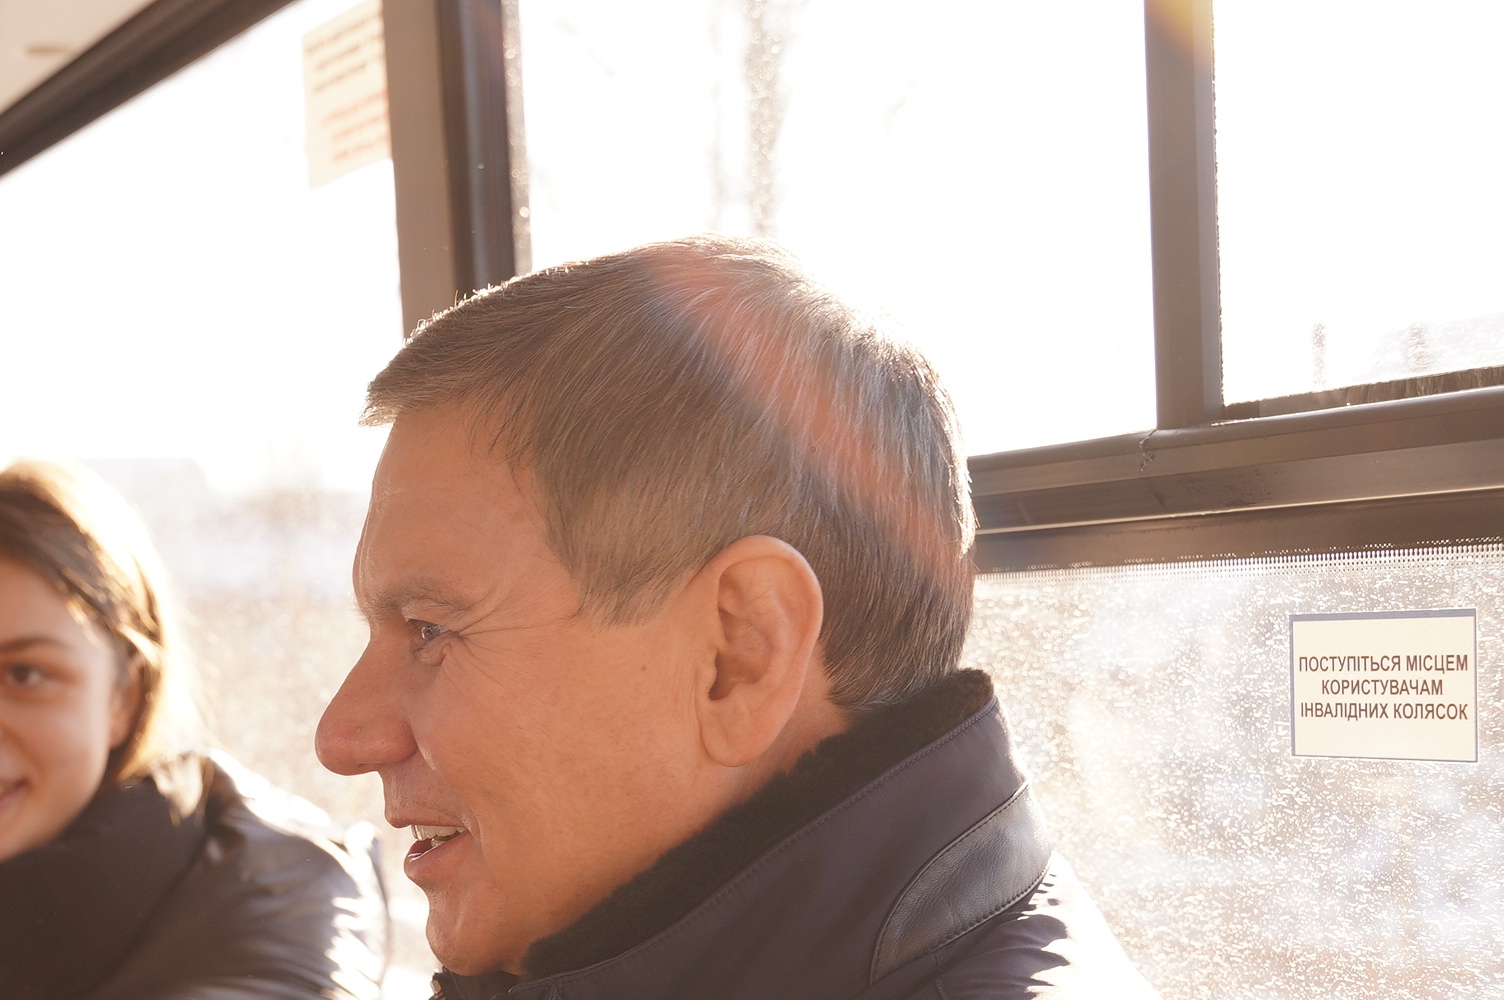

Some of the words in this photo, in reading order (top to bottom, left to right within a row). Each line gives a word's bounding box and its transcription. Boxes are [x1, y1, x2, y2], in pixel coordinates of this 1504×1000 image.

[1299, 655, 1401, 673] ПОСТУПІТЬСЯ
[1406, 654, 1468, 674] МІСЦЕМ
[1321, 679, 1443, 696] КОРИСТУВАЧАМ
[1300, 702, 1389, 721] ІНВАЛІДНИХ
[1393, 703, 1468, 720] КОЛЯСОК
